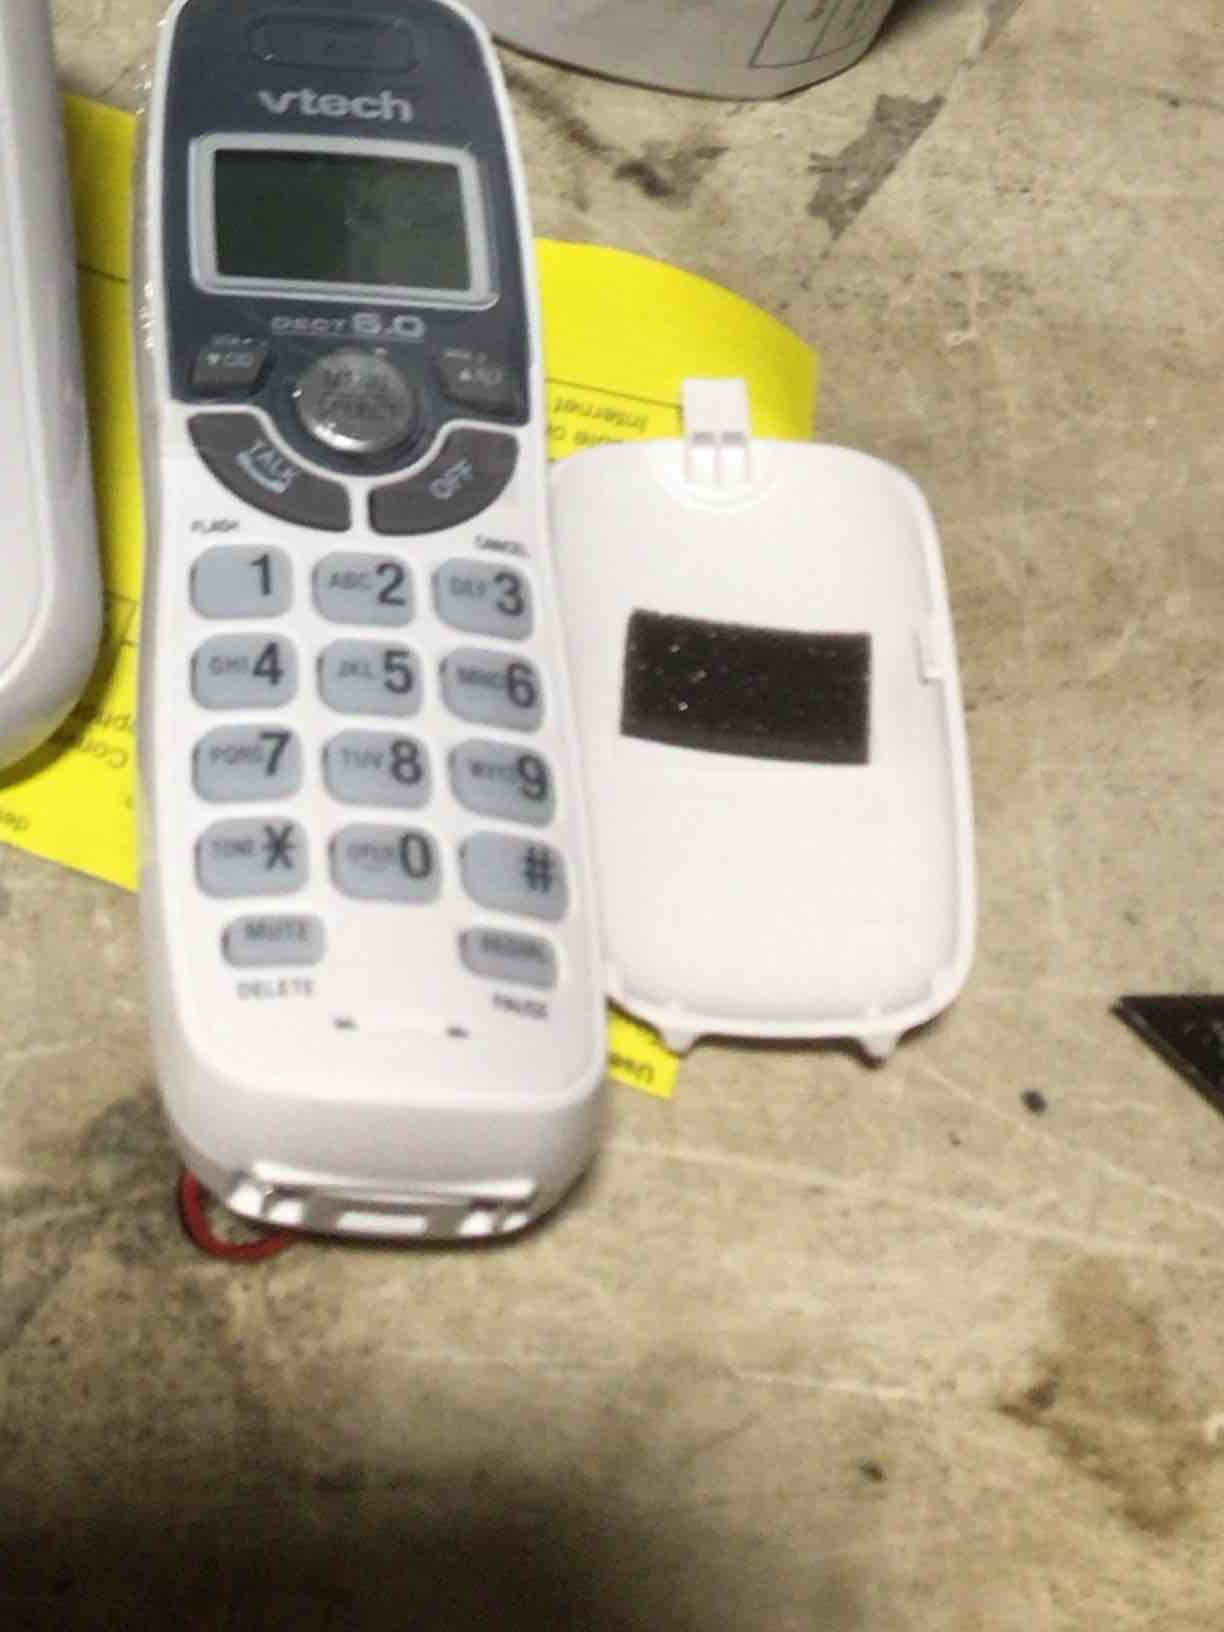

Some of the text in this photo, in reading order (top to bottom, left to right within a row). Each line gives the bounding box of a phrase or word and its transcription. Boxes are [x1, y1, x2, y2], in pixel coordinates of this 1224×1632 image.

[258, 87, 415, 123] vtech
[271, 312, 426, 341] DECT 6.0
[552, 398, 648, 433] Internet
[250, 553, 272, 597] 1
[376, 560, 407, 606] 2
[493, 570, 525, 617] 3
[252, 641, 285, 687] 4
[383, 649, 414, 695] 5
[506, 662, 536, 709] 6
[260, 729, 292, 778] 7
[389, 737, 423, 786] 8
[518, 752, 550, 804] 9
[398, 831, 432, 880] 0
[522, 844, 554, 895] #
[244, 919, 310, 944] MUTE
[235, 977, 315, 1002] DELETE
